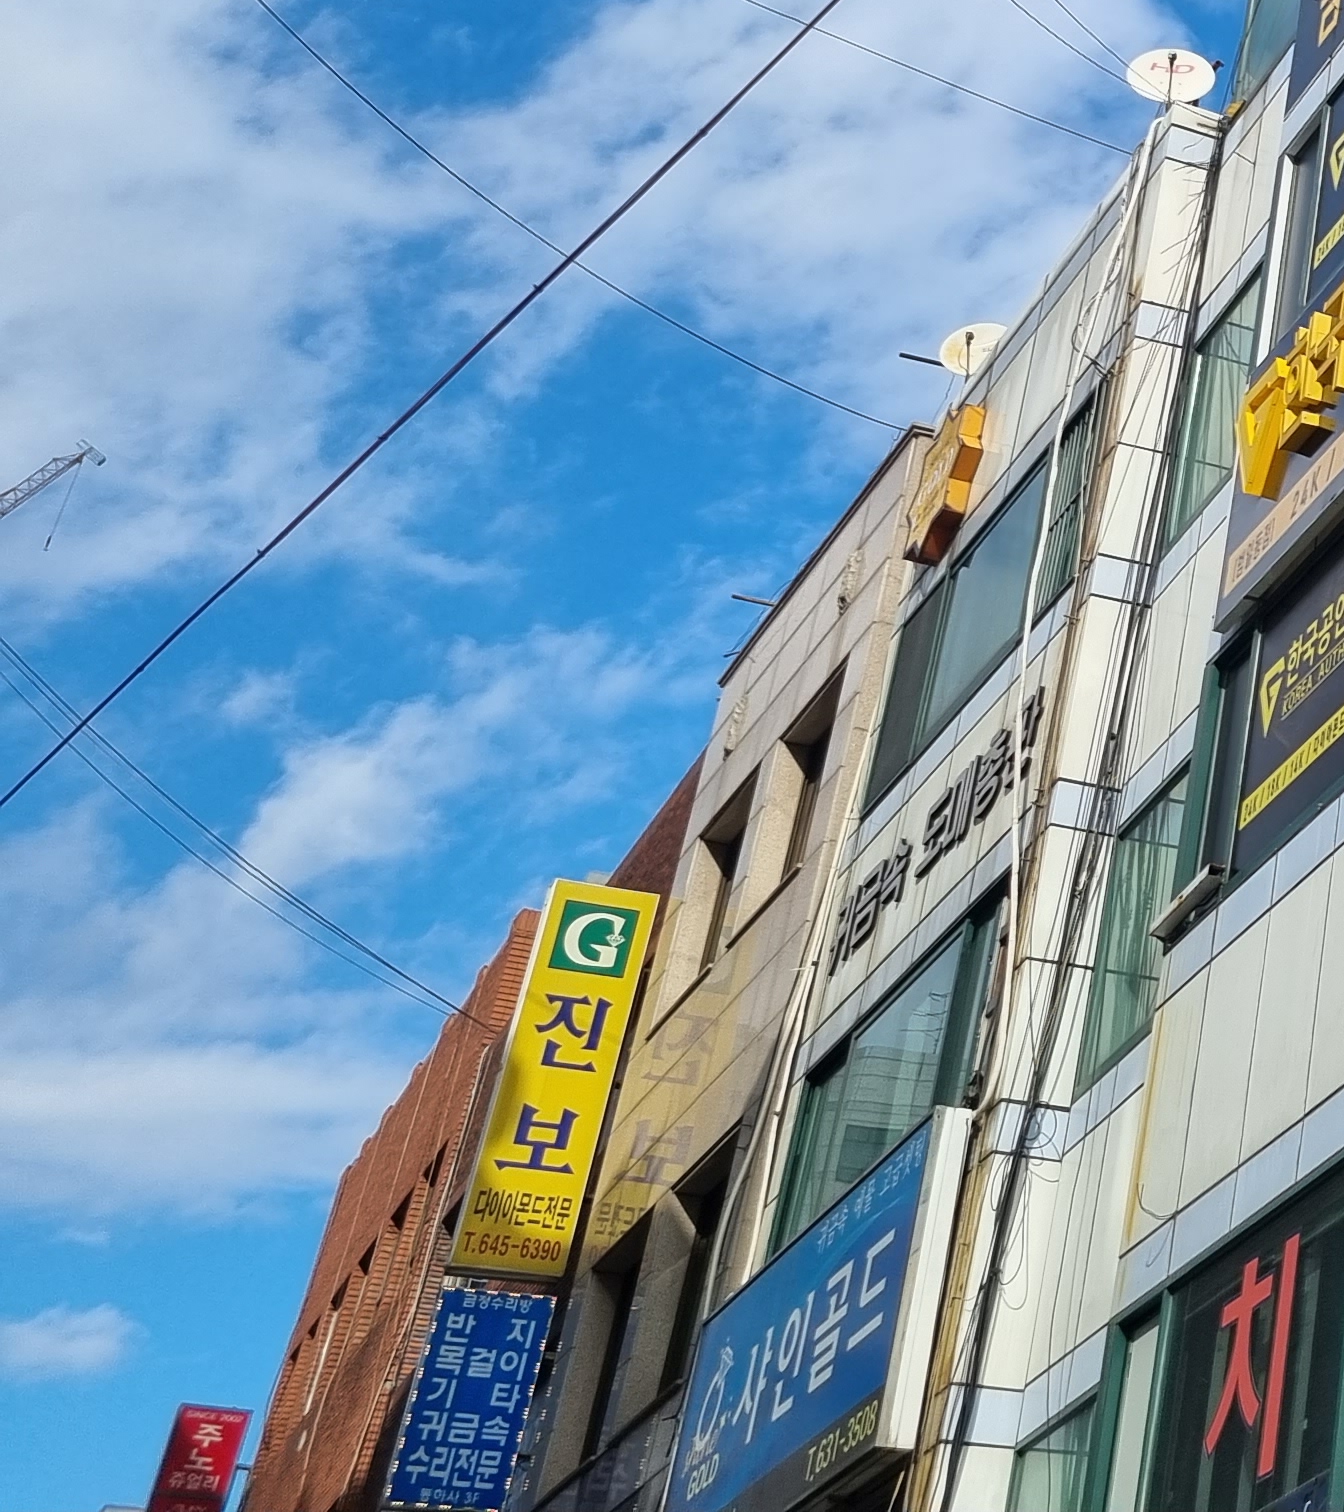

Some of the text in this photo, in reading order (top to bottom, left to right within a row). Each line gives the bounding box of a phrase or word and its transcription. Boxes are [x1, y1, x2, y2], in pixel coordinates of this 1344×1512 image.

[462, 1231, 561, 1263] T.645-6390
[732, 1227, 896, 1445] 샤인골드
[435, 1344, 528, 1381] 목걸이
[418, 1410, 510, 1446] 귀금속
[405, 1445, 502, 1489] 수리전문
[686, 1453, 719, 1501] GOLD
